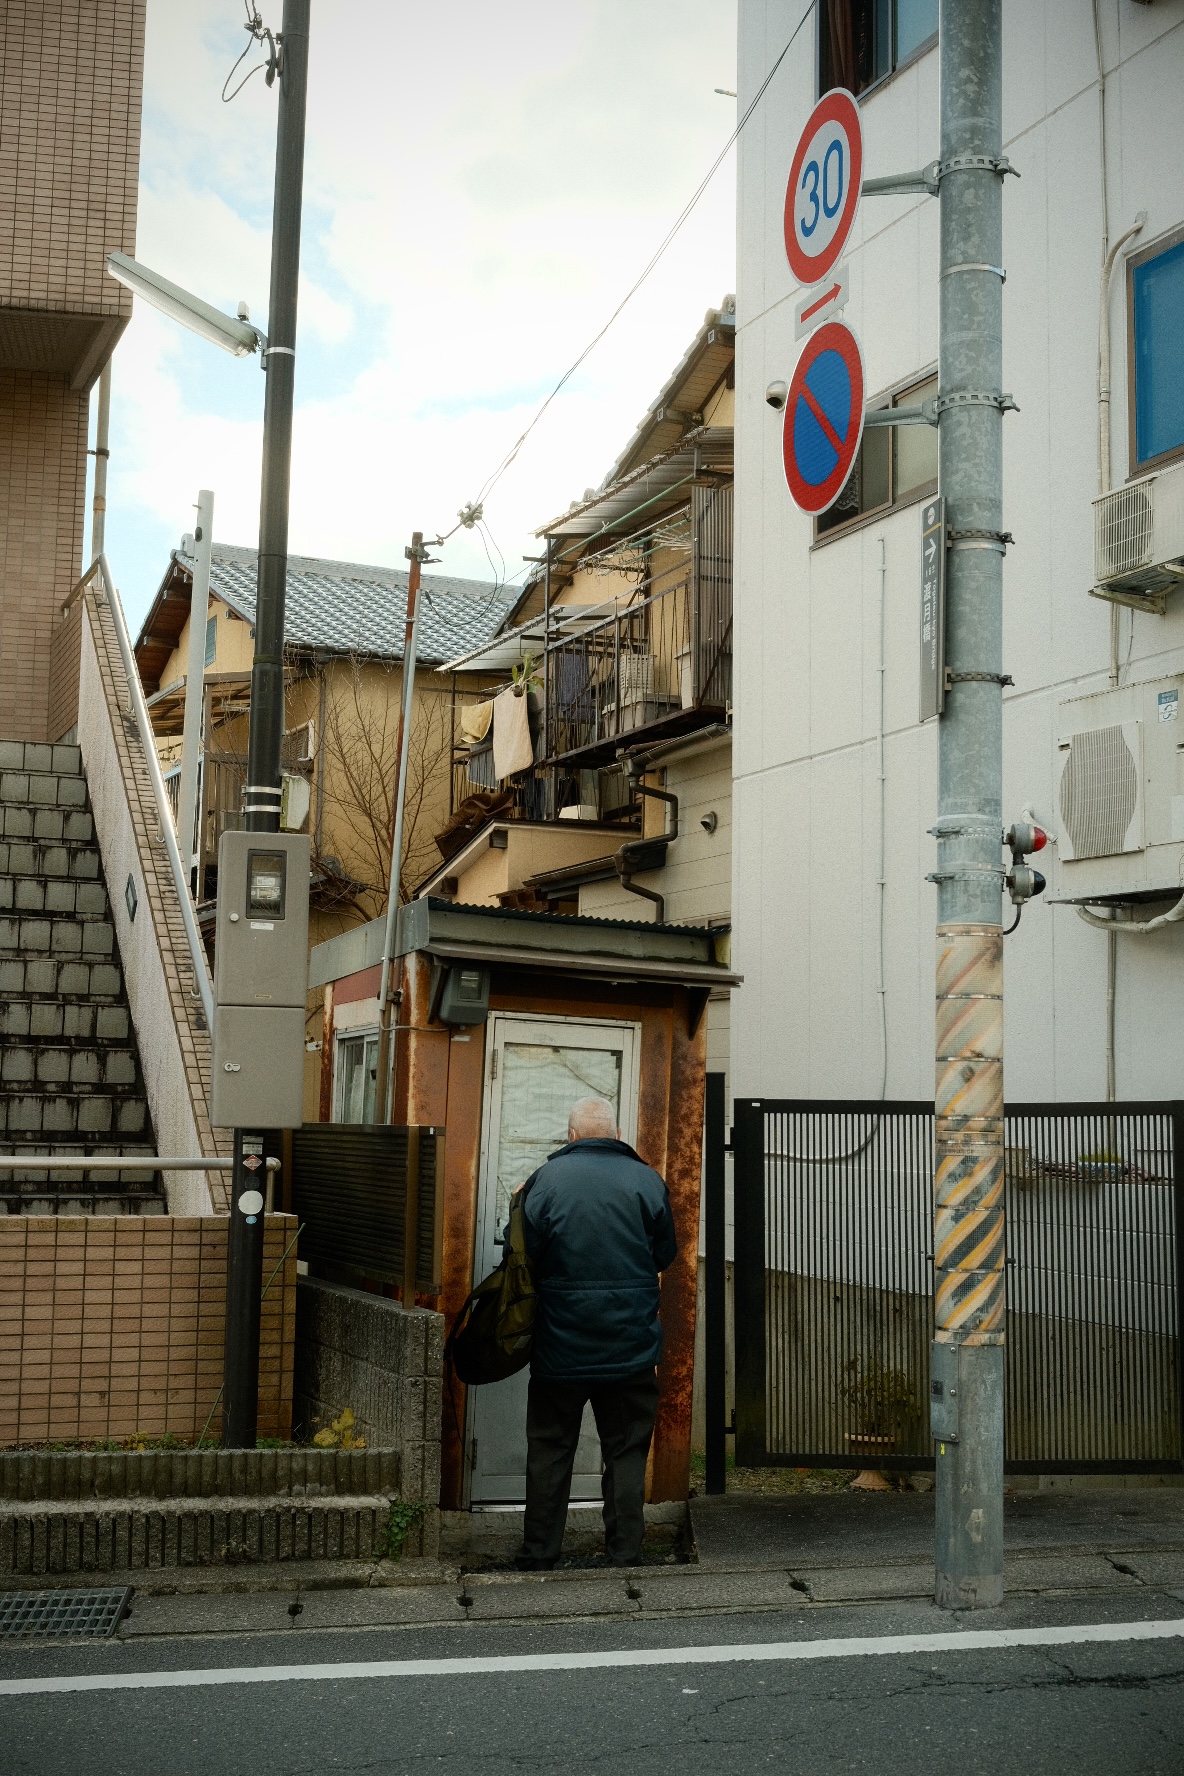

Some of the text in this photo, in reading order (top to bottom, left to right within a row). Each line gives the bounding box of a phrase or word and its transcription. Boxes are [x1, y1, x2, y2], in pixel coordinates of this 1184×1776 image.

[801, 139, 843, 238] 30
[922, 581, 932, 643] 渡月橋
